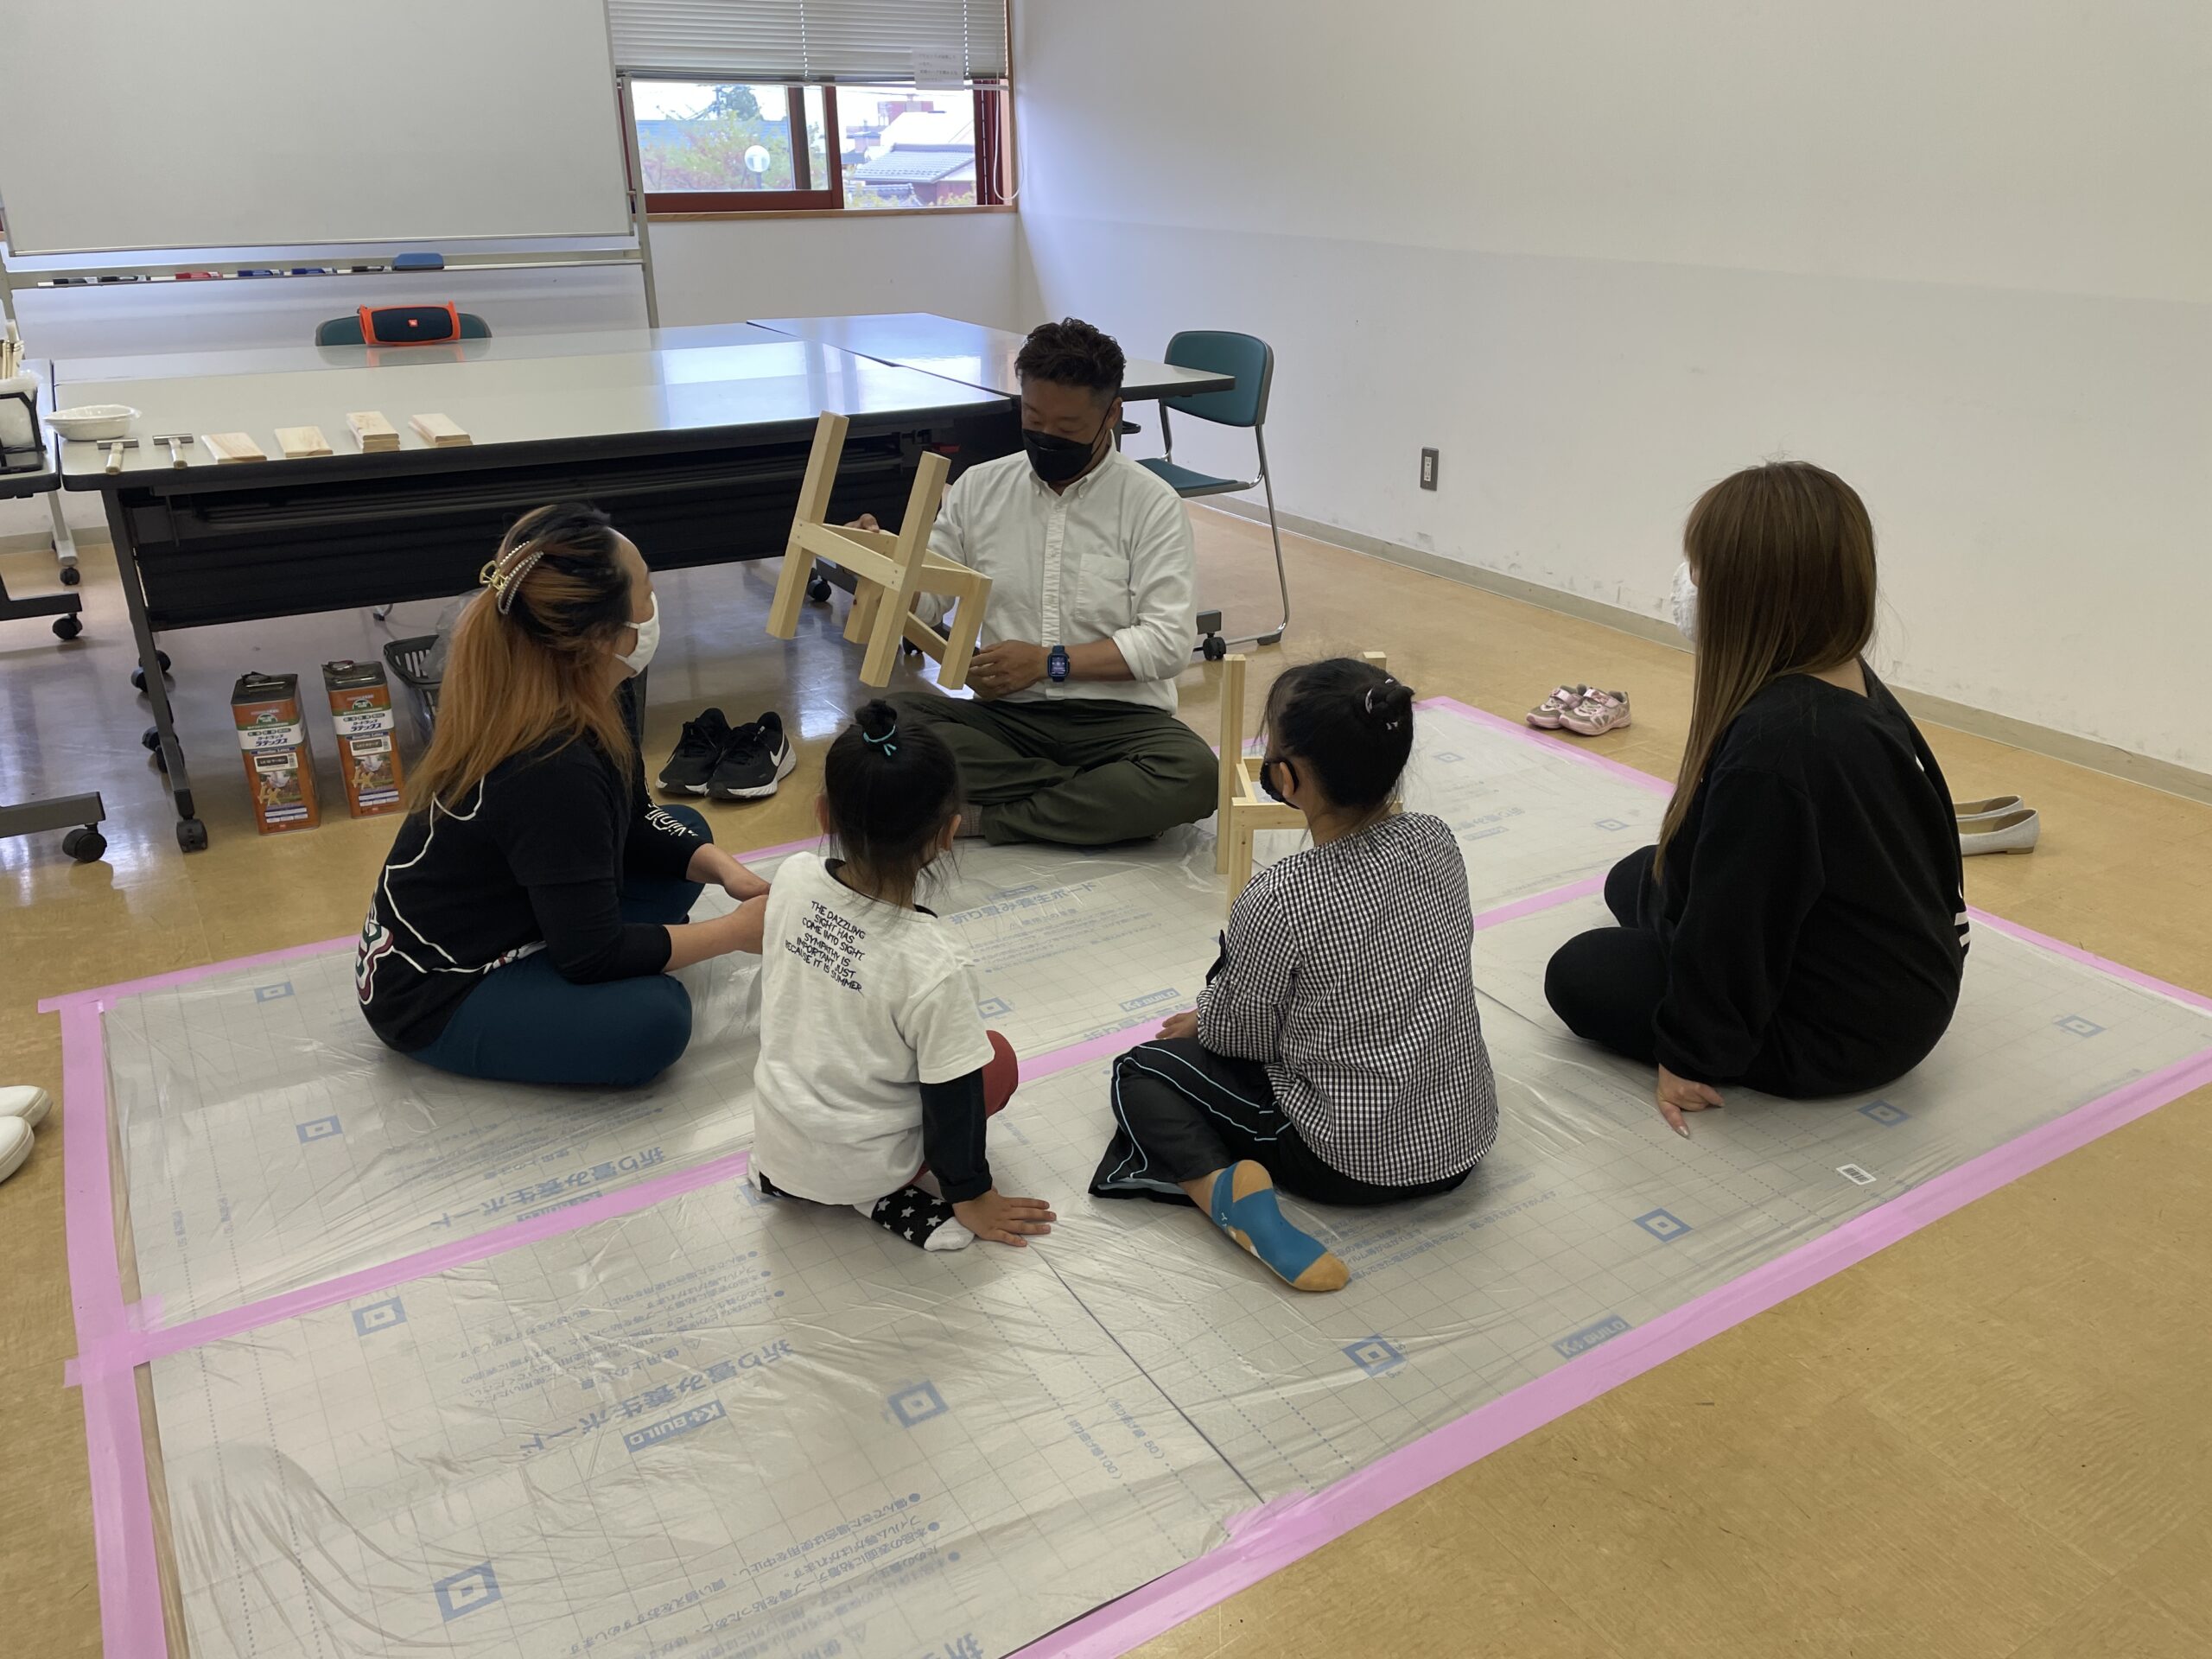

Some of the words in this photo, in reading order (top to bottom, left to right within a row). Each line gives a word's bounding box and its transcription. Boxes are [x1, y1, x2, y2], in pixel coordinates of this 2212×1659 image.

[802, 917, 822, 935] COME
[823, 930, 839, 945] INTO
[811, 900, 826, 916] THE
[827, 911, 866, 939] DAZZLING
[814, 914, 837, 932] SIGHT
[837, 929, 855, 944] HAS
[785, 939, 810, 963] BECAUSE
[813, 958, 822, 969] IT
[823, 963, 830, 974] IS
[830, 970, 862, 993] SUMMER
[797, 937, 835, 966] IMPORTANT
[834, 963, 856, 979] JUST
[804, 933, 840, 960] SYMPATHY
[841, 957, 850, 967] IS
[431, 1147, 665, 1228] 折り畳み養生ボード
[519, 1338, 793, 1459] 折り畳み養生ボード
[784, 1515, 919, 1580] フィルム等がはがれます。
